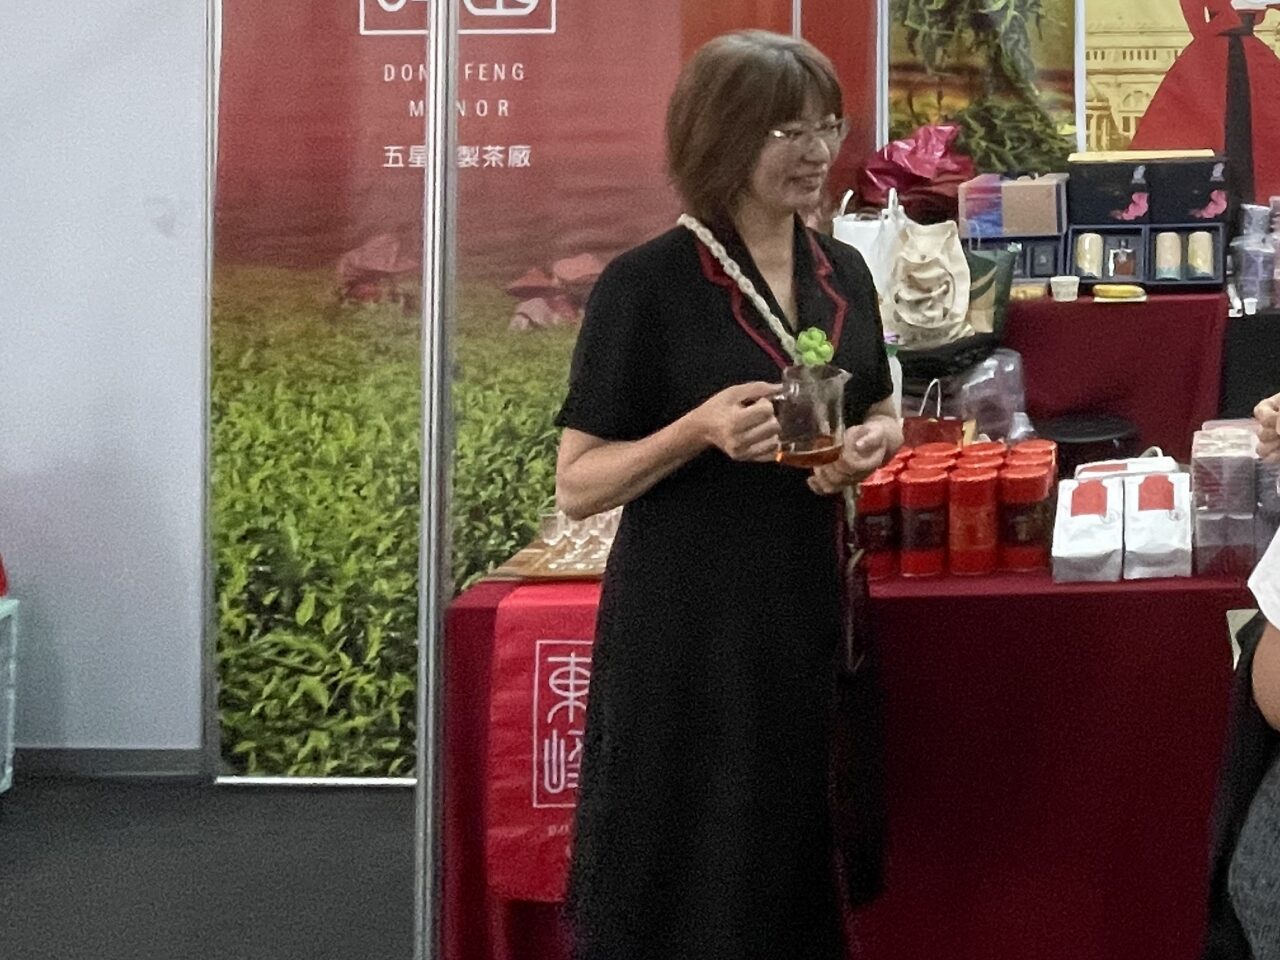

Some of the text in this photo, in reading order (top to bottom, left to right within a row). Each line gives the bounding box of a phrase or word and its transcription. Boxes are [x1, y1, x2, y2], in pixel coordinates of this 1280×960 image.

[384, 63, 525, 82] DON FENG
[409, 99, 510, 118] MNOR
[383, 145, 532, 168] 五星製茶廠
